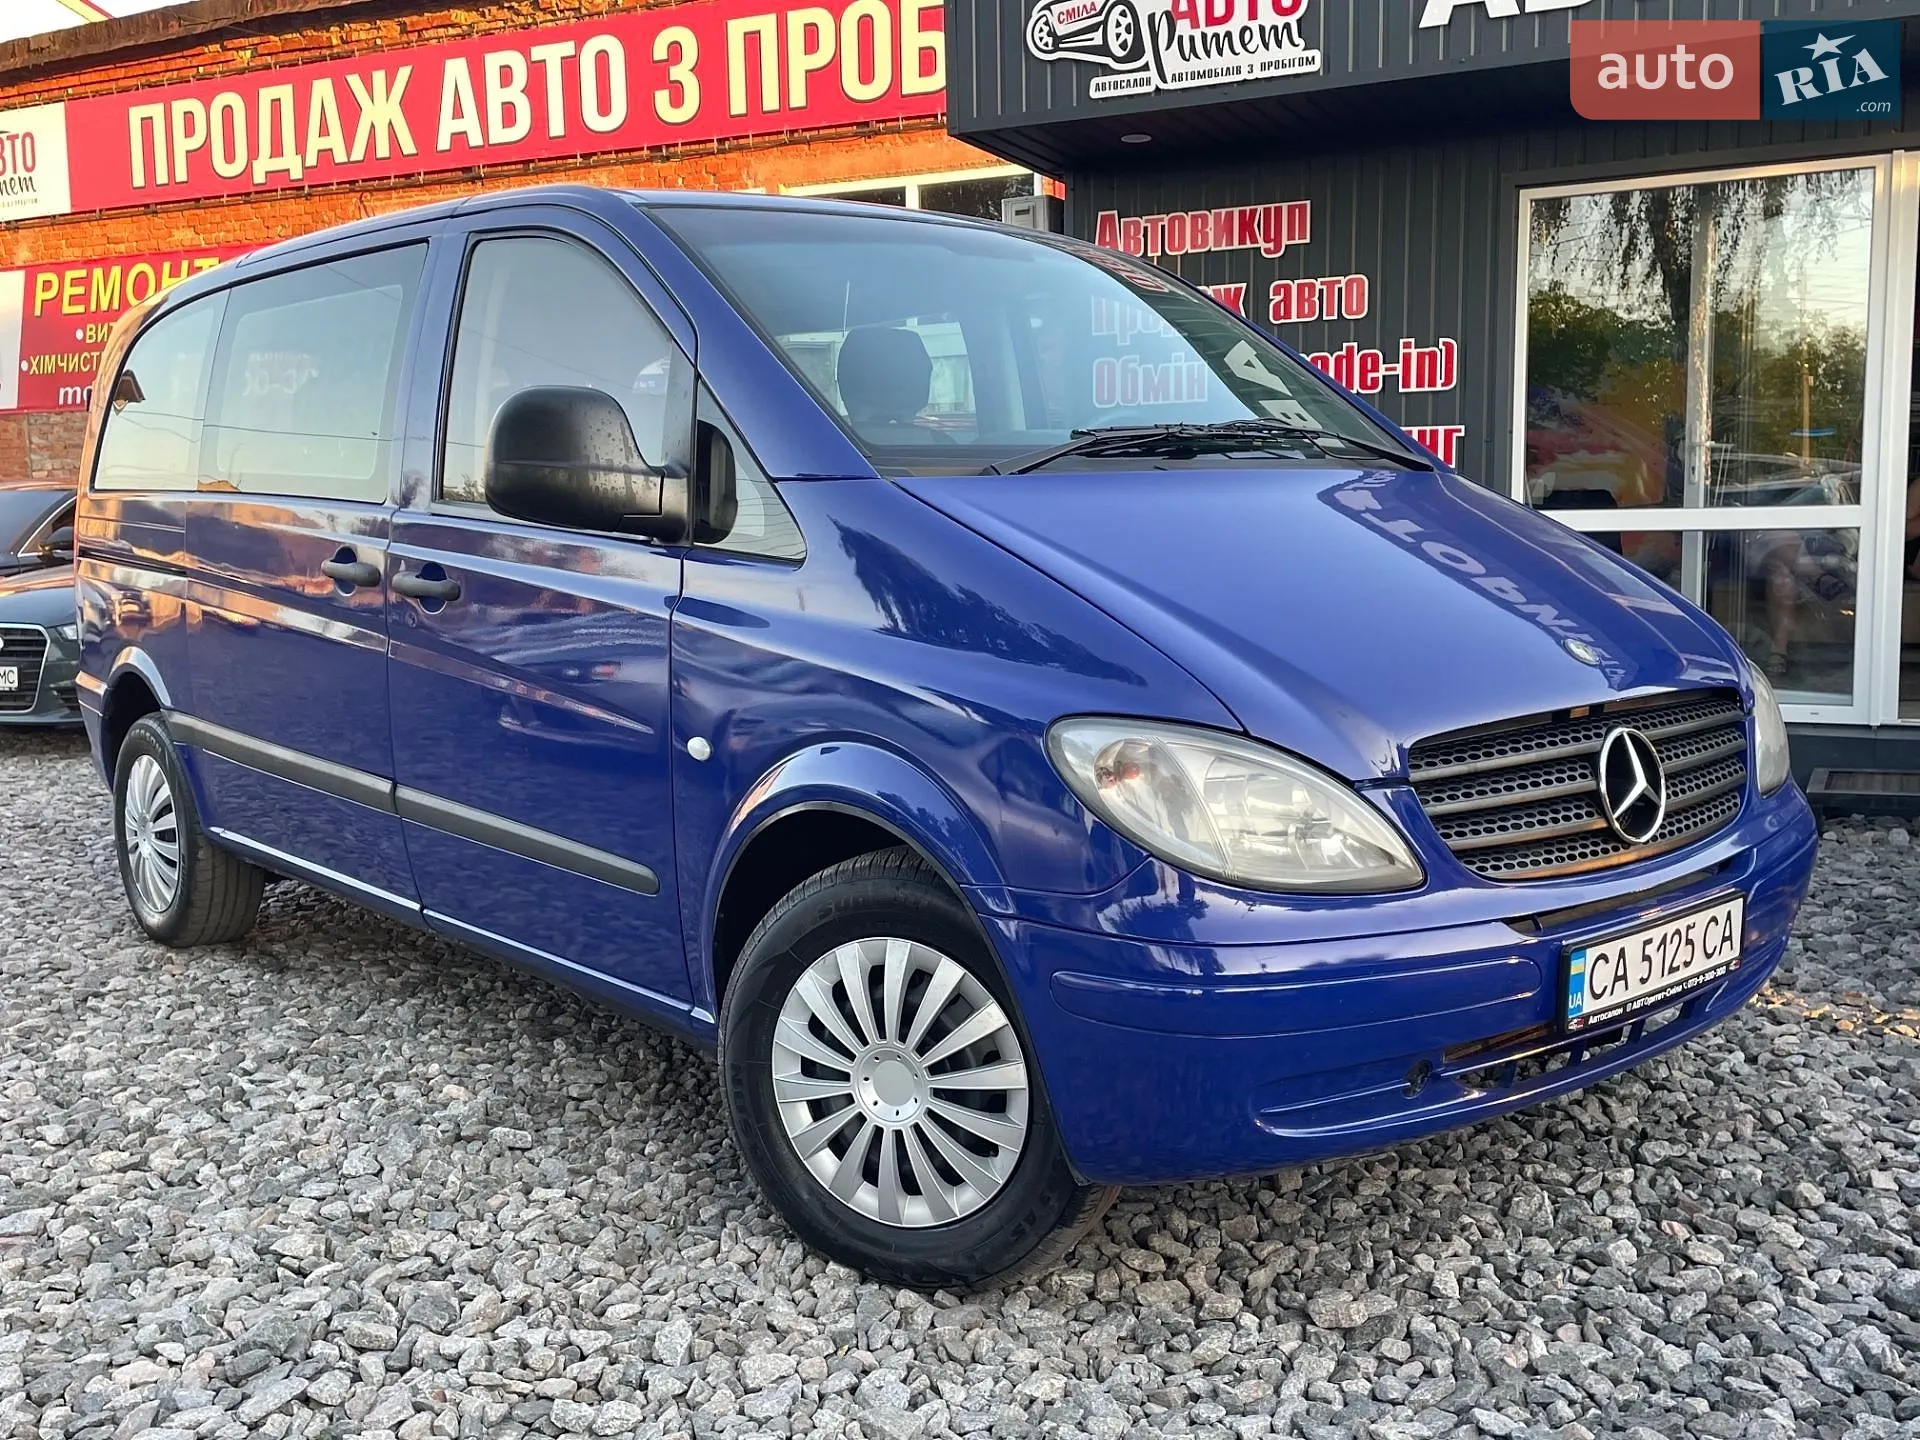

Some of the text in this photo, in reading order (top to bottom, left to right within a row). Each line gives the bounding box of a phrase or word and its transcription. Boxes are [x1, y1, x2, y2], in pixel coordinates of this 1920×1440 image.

[1057, 1, 1097, 25] СМІЛА
[1094, 76, 1152, 93] АВТОСАЛОН
[1171, 65, 1242, 84] АВТОМОБІЛІВ
[1260, 55, 1316, 72] ПРОБІГОМ
[128, 64, 418, 189] ПРОДАЖ
[437, 34, 628, 152] АВТО
[1095, 200, 1311, 258] Автовикуп
[1269, 274, 1368, 324] авто
[29, 351, 104, 375] ХІМЧИСТ
[1093, 353, 1208, 408] Обмін
[1589, 909, 1734, 1000] CA 5125 CA
[1568, 991, 1583, 1009] UA
